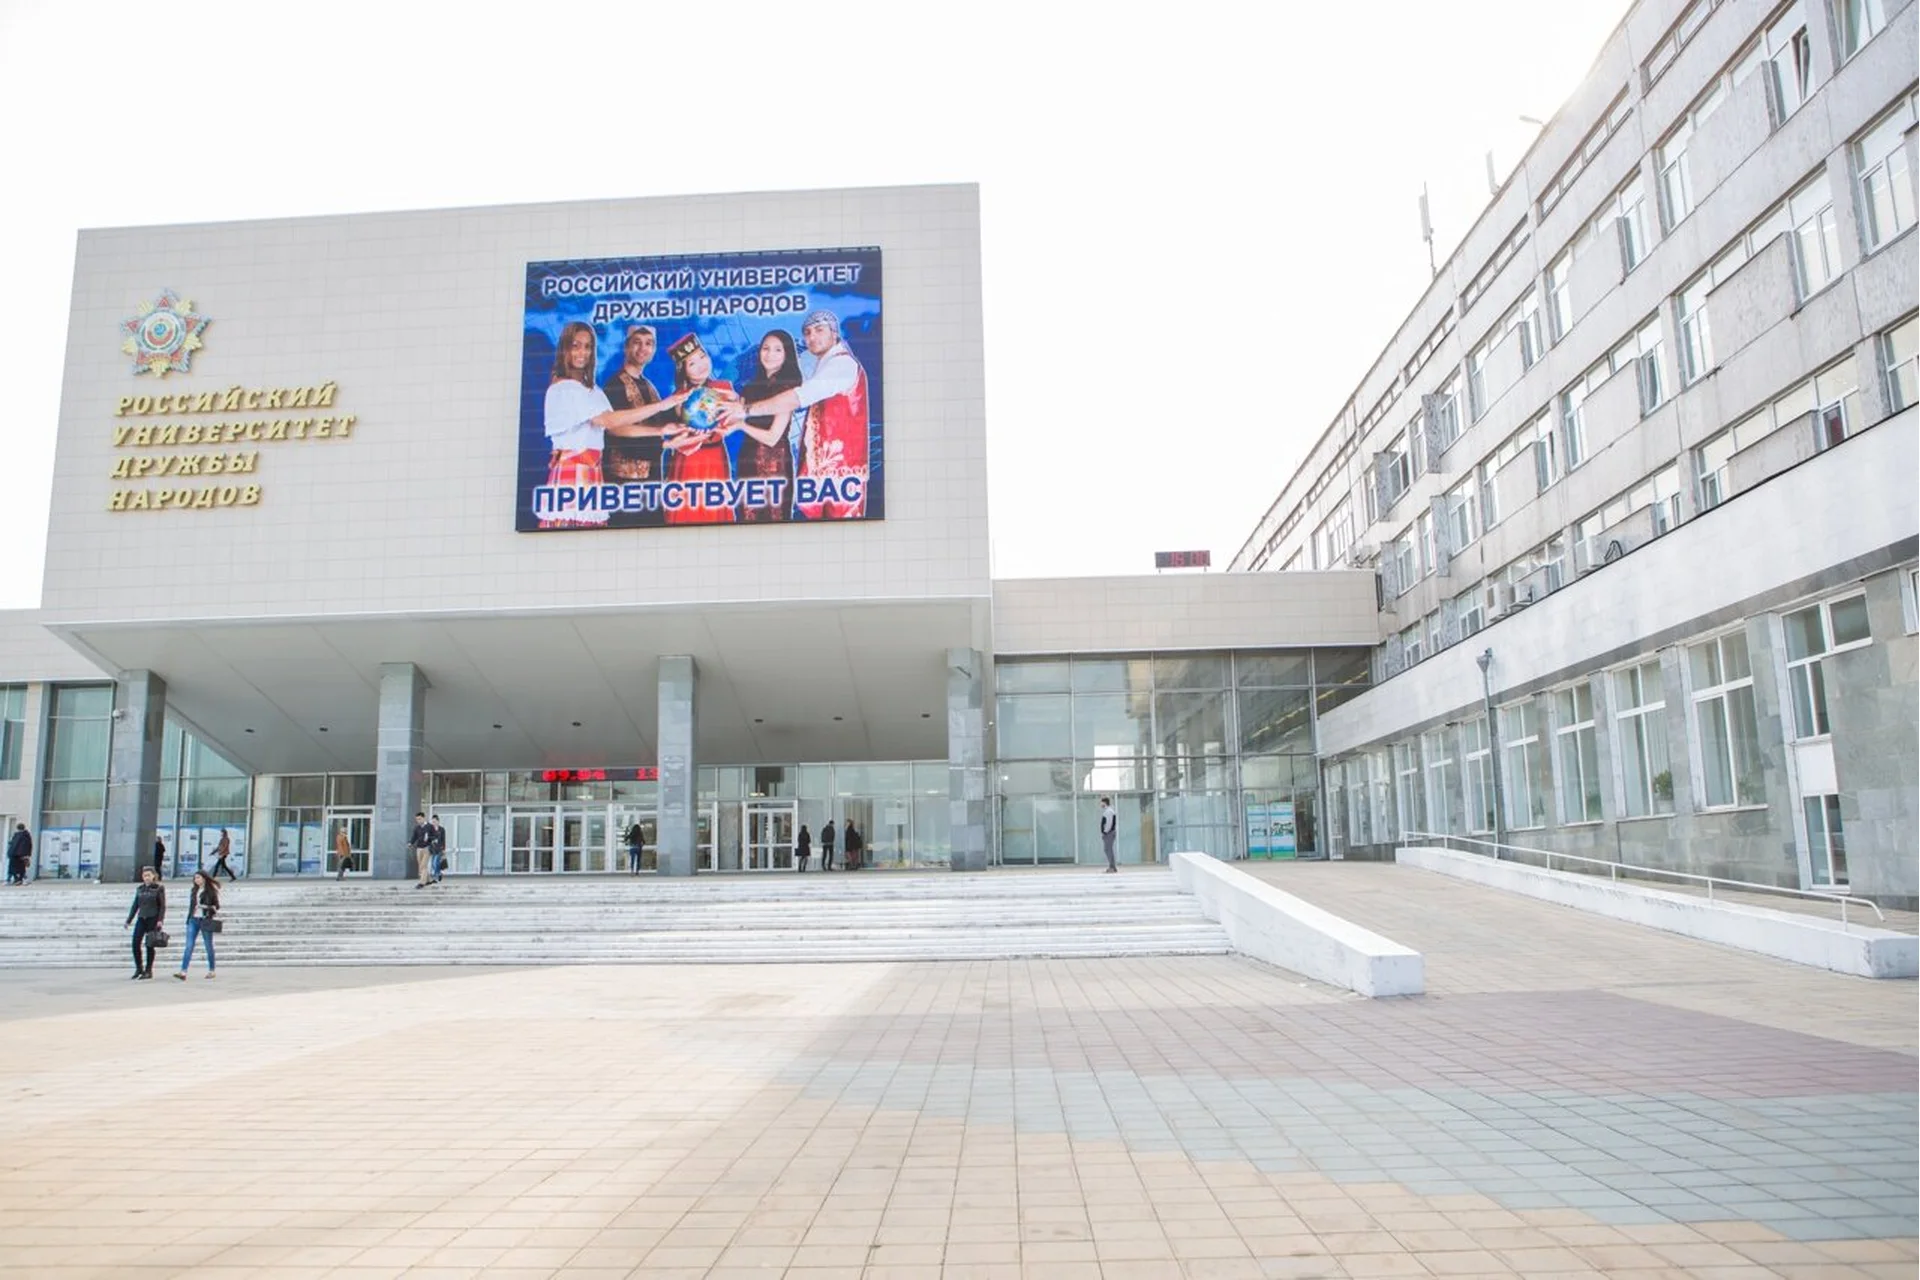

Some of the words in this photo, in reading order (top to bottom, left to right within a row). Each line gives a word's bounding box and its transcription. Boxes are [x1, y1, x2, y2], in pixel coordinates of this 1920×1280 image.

[543, 267, 694, 296] РОССИЙСКИЙ
[700, 264, 861, 289] УНИВЕРСИТЕТ
[593, 298, 691, 323] ДРУЖБЫ
[699, 294, 808, 316] НАРОДОВ
[115, 380, 338, 416] РОССИЙСКИЙ
[113, 415, 355, 447] УНИВЕРСИТЕТ
[109, 451, 260, 478] ДРУЖБЫ
[108, 483, 261, 511] НАРОДОВ
[534, 479, 787, 514] ПРИВЕТСТВУЕТ
[796, 476, 863, 505] ВАС
